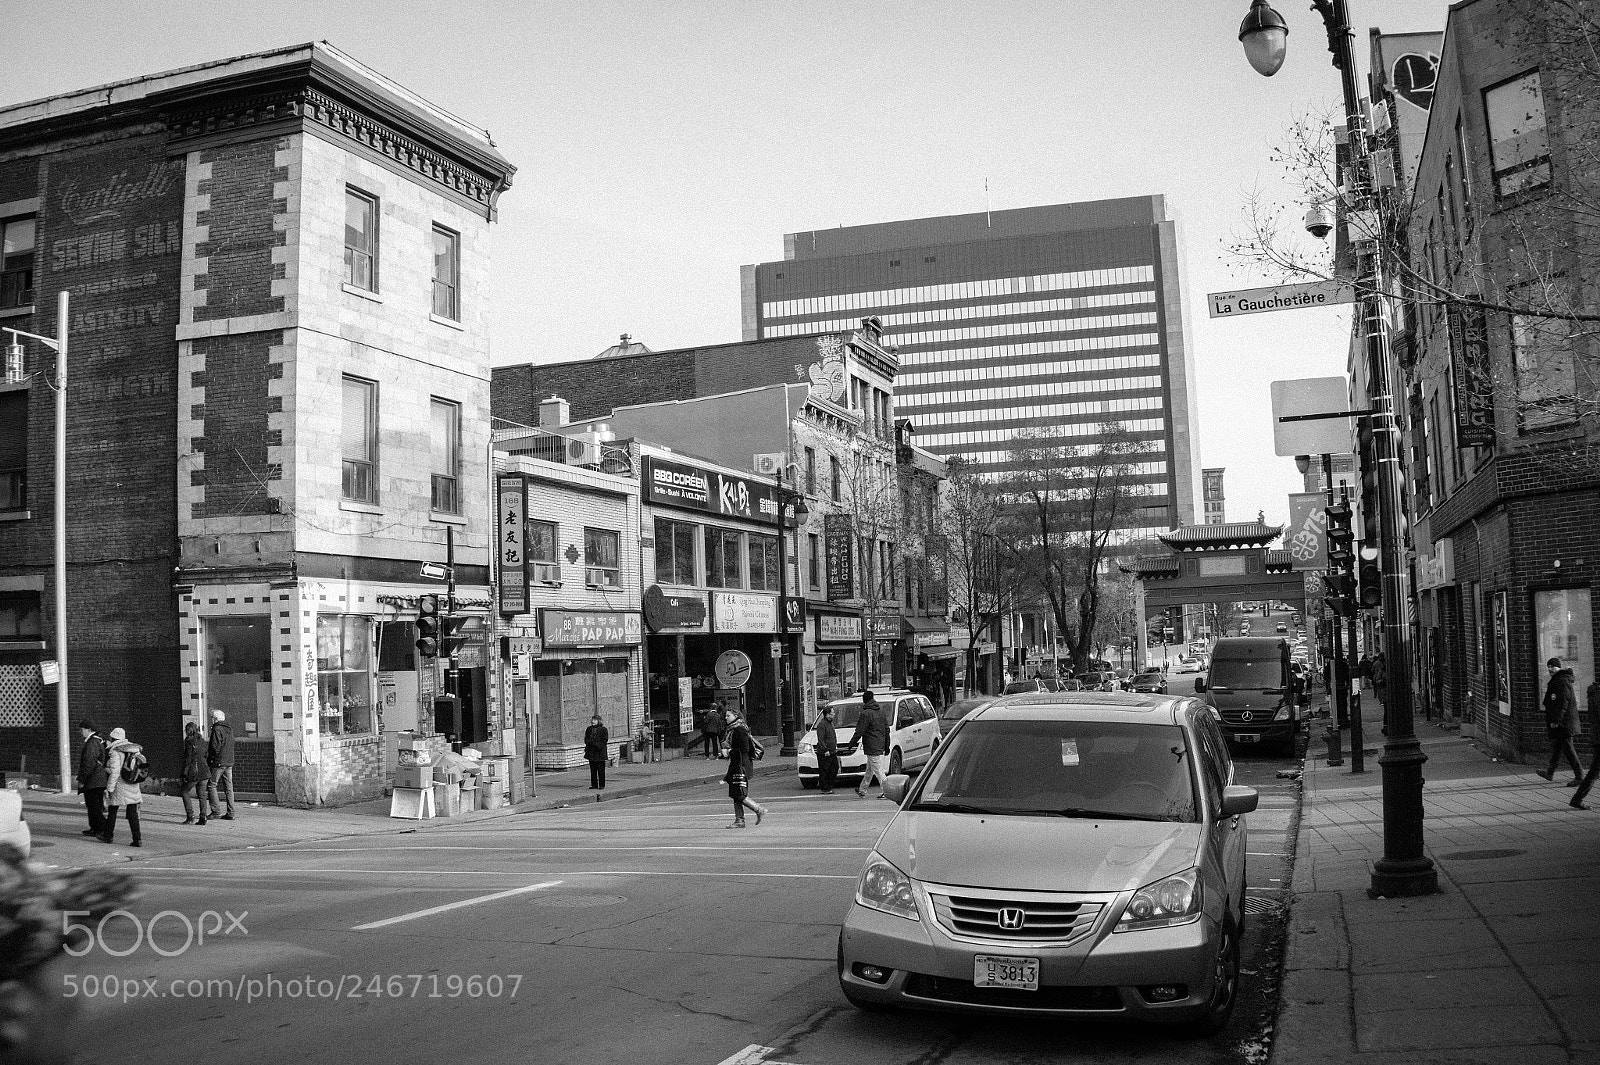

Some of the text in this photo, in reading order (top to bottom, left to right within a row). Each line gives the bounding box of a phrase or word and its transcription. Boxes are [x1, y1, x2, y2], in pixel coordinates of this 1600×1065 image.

[134, 219, 180, 258] SILK
[1216, 292, 1325, 314] La Gauchetière
[654, 468, 706, 490] BBQ CORÉEN
[504, 510, 520, 562] 老友記
[563, 619, 572, 631] 88
[582, 627, 603, 641] PAP
[605, 627, 624, 640] PAP
[1000, 965, 1035, 982] 3813
